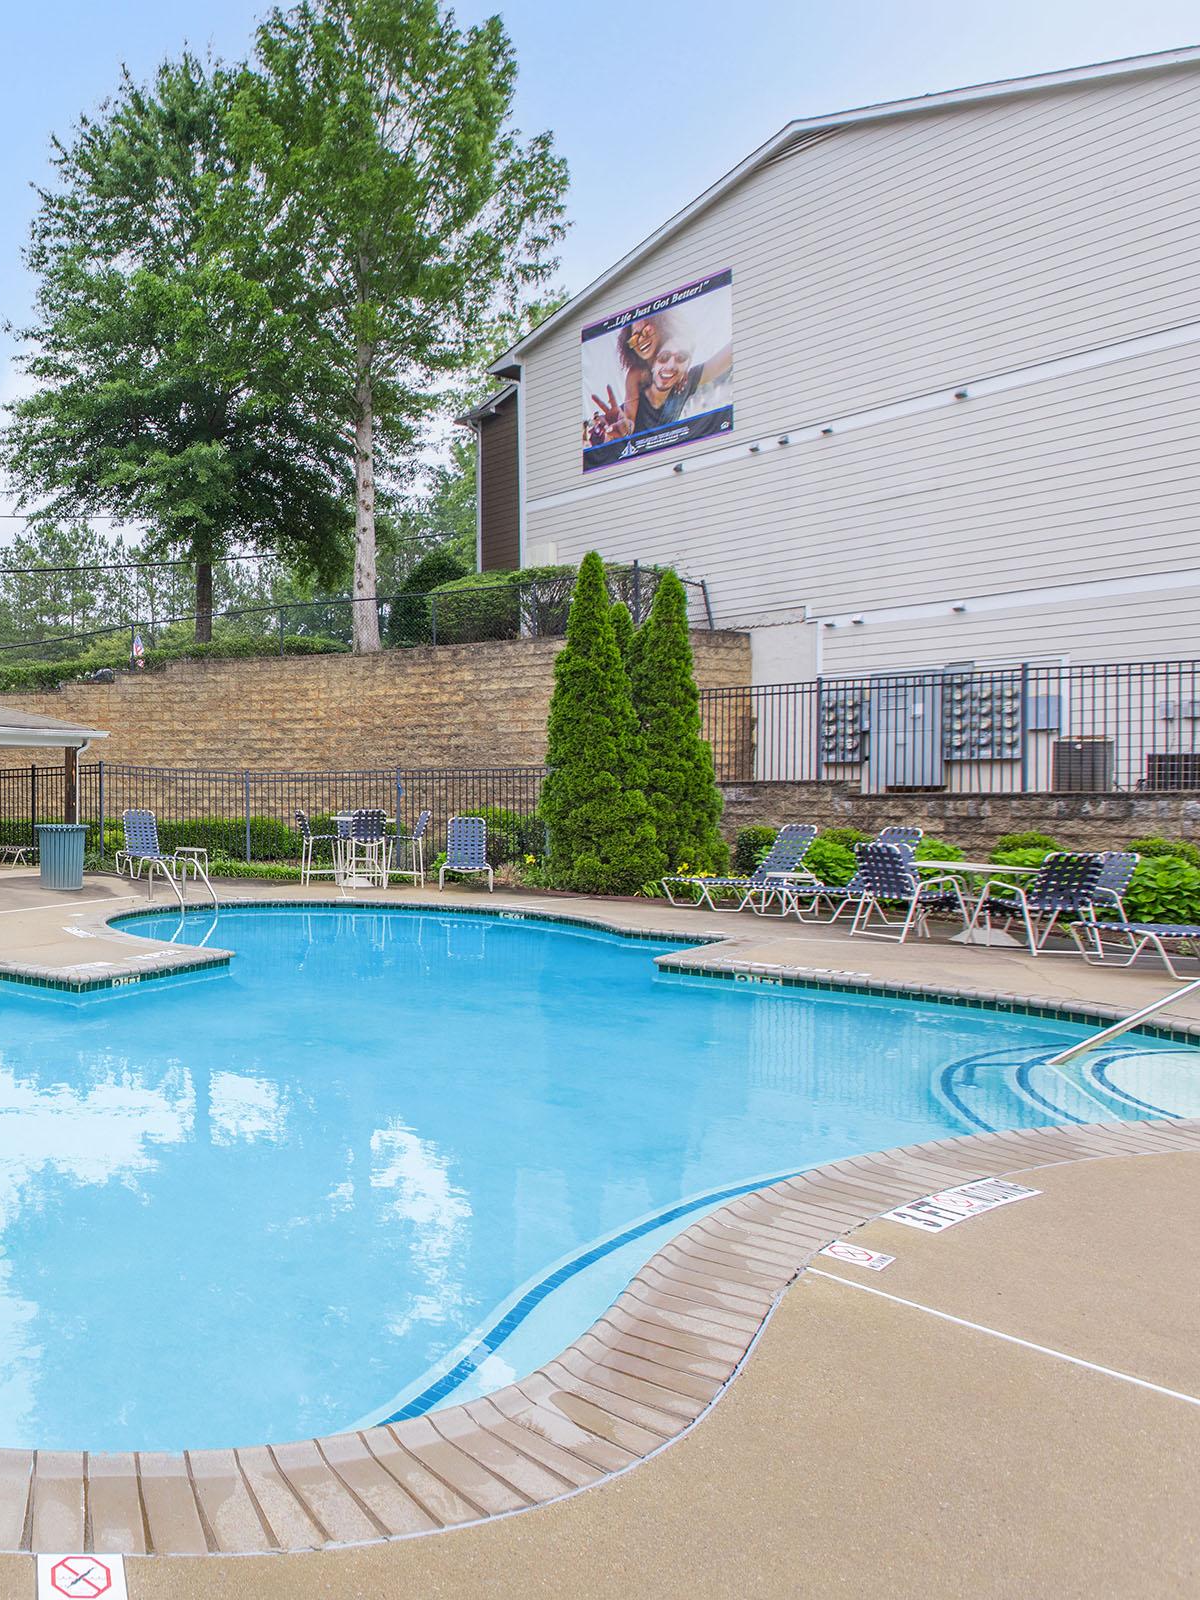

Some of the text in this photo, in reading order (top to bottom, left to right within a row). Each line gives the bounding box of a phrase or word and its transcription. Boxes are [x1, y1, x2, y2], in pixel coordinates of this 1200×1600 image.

[633, 305, 651, 319] Just
[653, 297, 670, 311] Got
[892, 1211, 942, 1228] 3
[906, 1201, 966, 1221] FT
